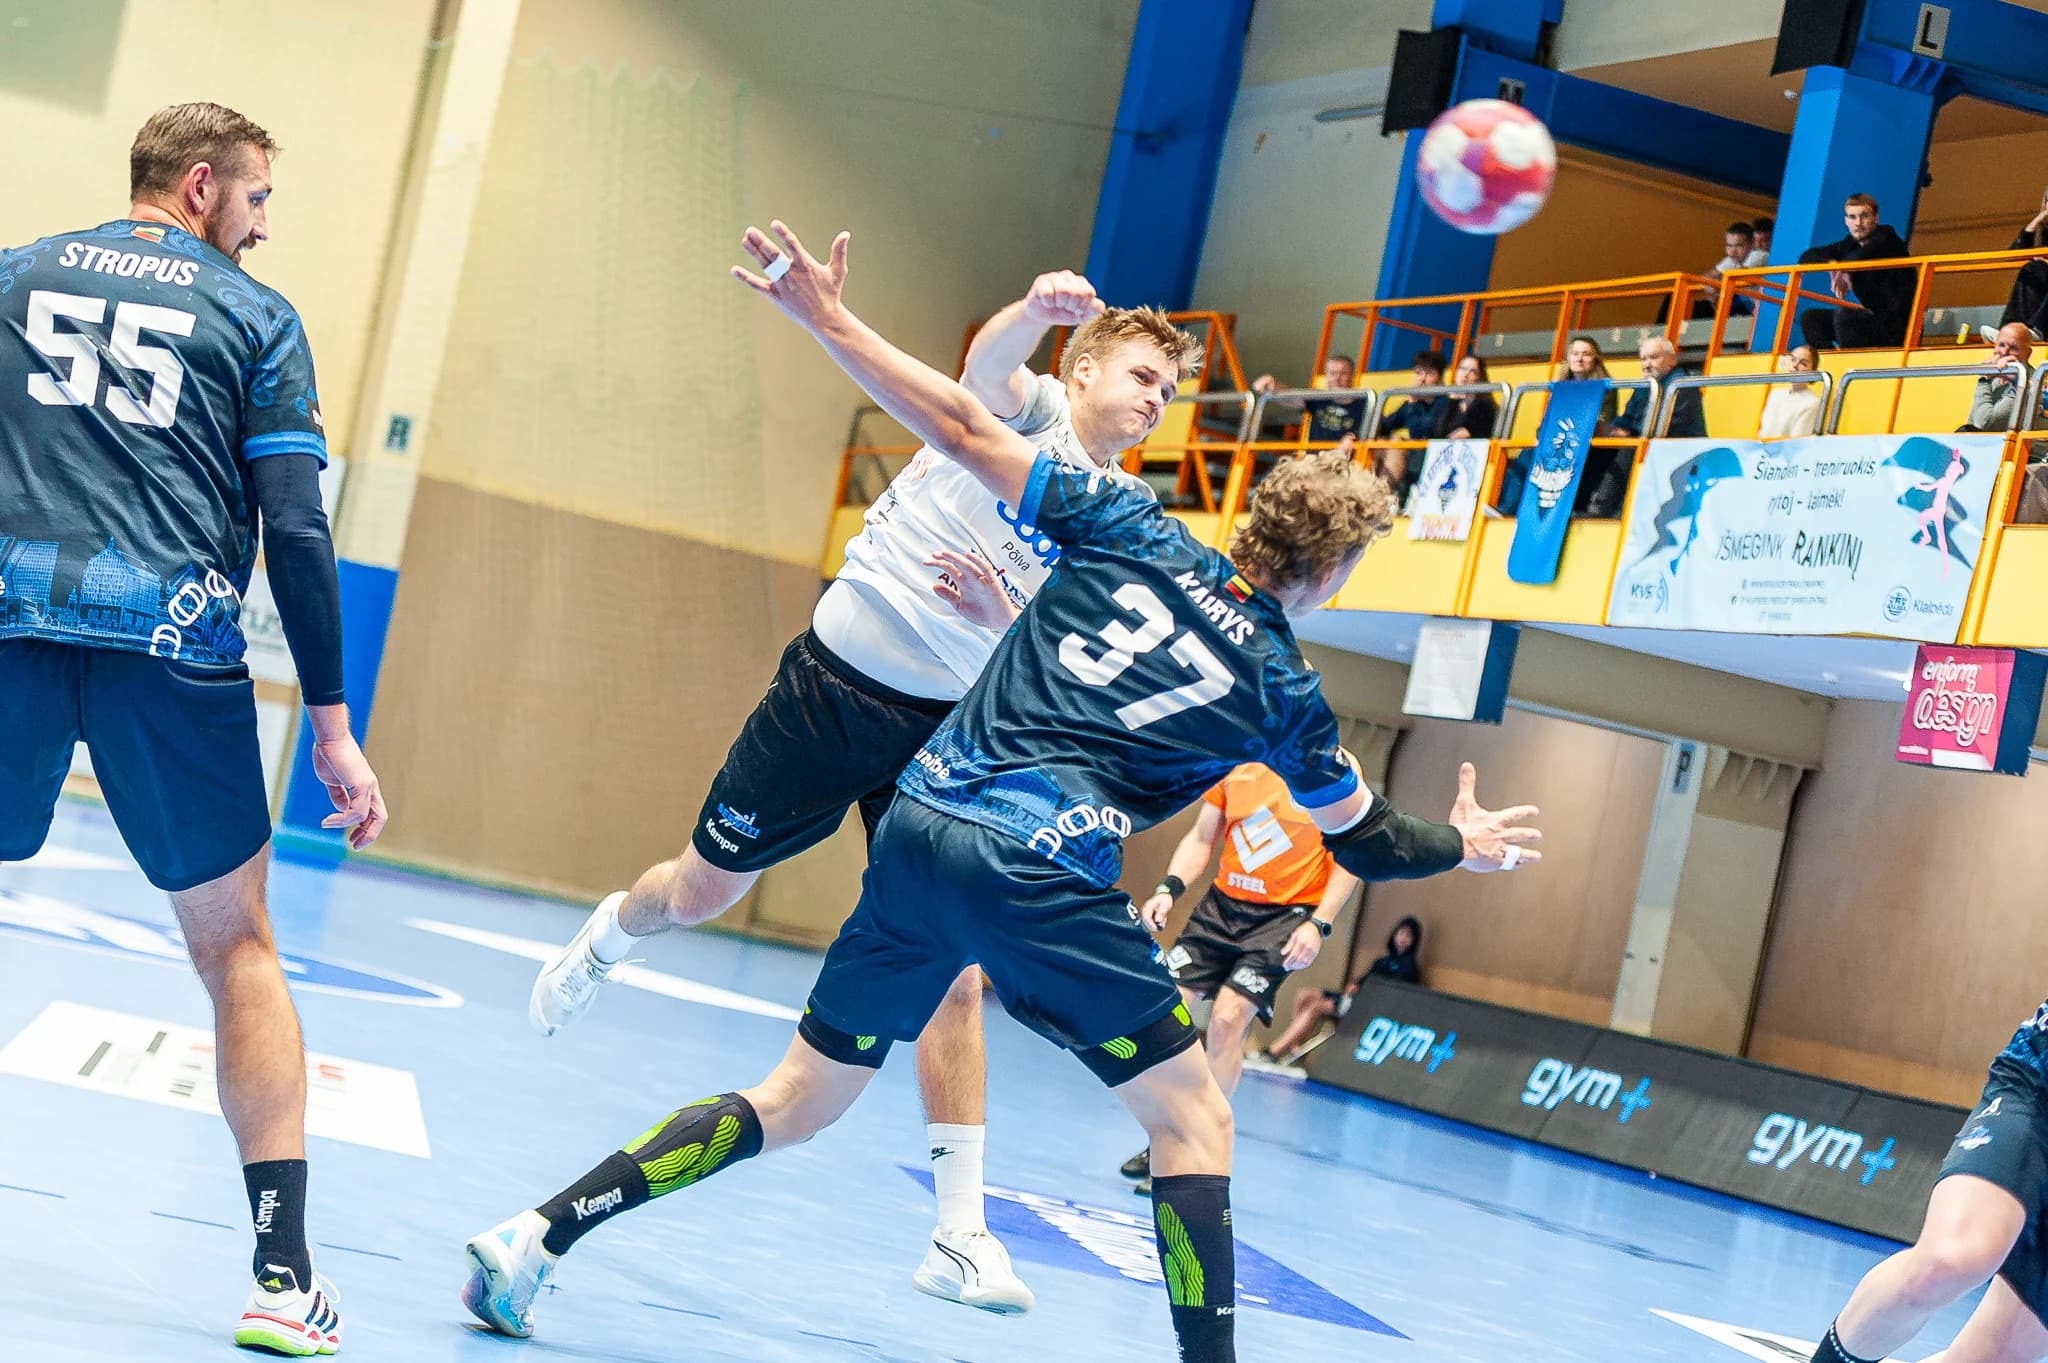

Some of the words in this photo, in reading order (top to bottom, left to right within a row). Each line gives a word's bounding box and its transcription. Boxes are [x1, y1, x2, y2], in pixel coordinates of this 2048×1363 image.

[1920, 10, 1938, 50] L
[58, 242, 200, 287] STROPUS
[24, 289, 197, 428] 55
[1000, 540, 1031, 572] Põlva
[1174, 570, 1255, 646] KAIRYS
[1058, 582, 1236, 731] 37
[705, 818, 739, 854] Kempa
[1227, 871, 1268, 894] STEEL
[255, 1188, 281, 1234] Kempa
[571, 1187, 623, 1221] Kempa
